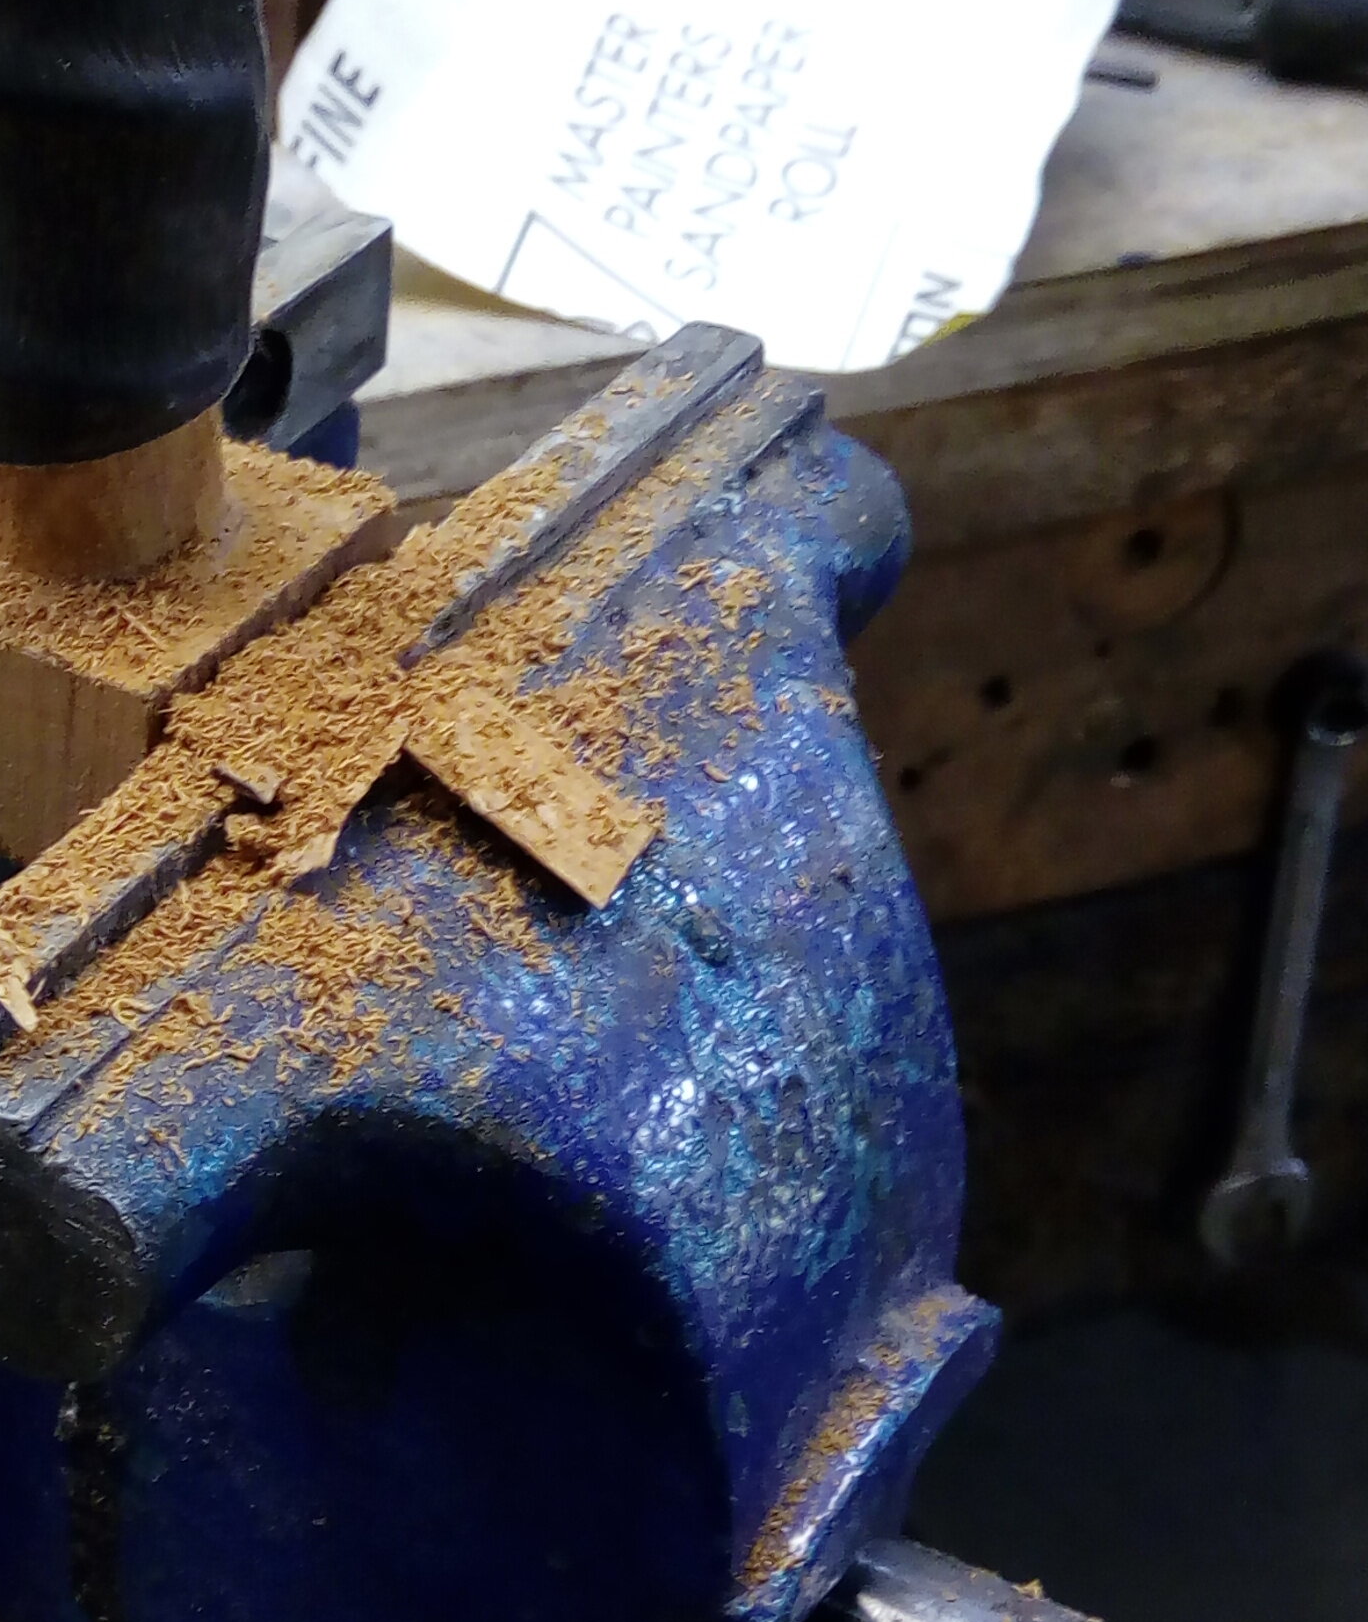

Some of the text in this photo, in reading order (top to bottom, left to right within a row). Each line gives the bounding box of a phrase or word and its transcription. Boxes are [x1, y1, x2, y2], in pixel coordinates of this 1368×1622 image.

[548, 12, 659, 202] MASTER
[602, 23, 733, 237] PAINTERS
[663, 19, 814, 291] SANDPAPER
[768, 123, 860, 224] ROLL
